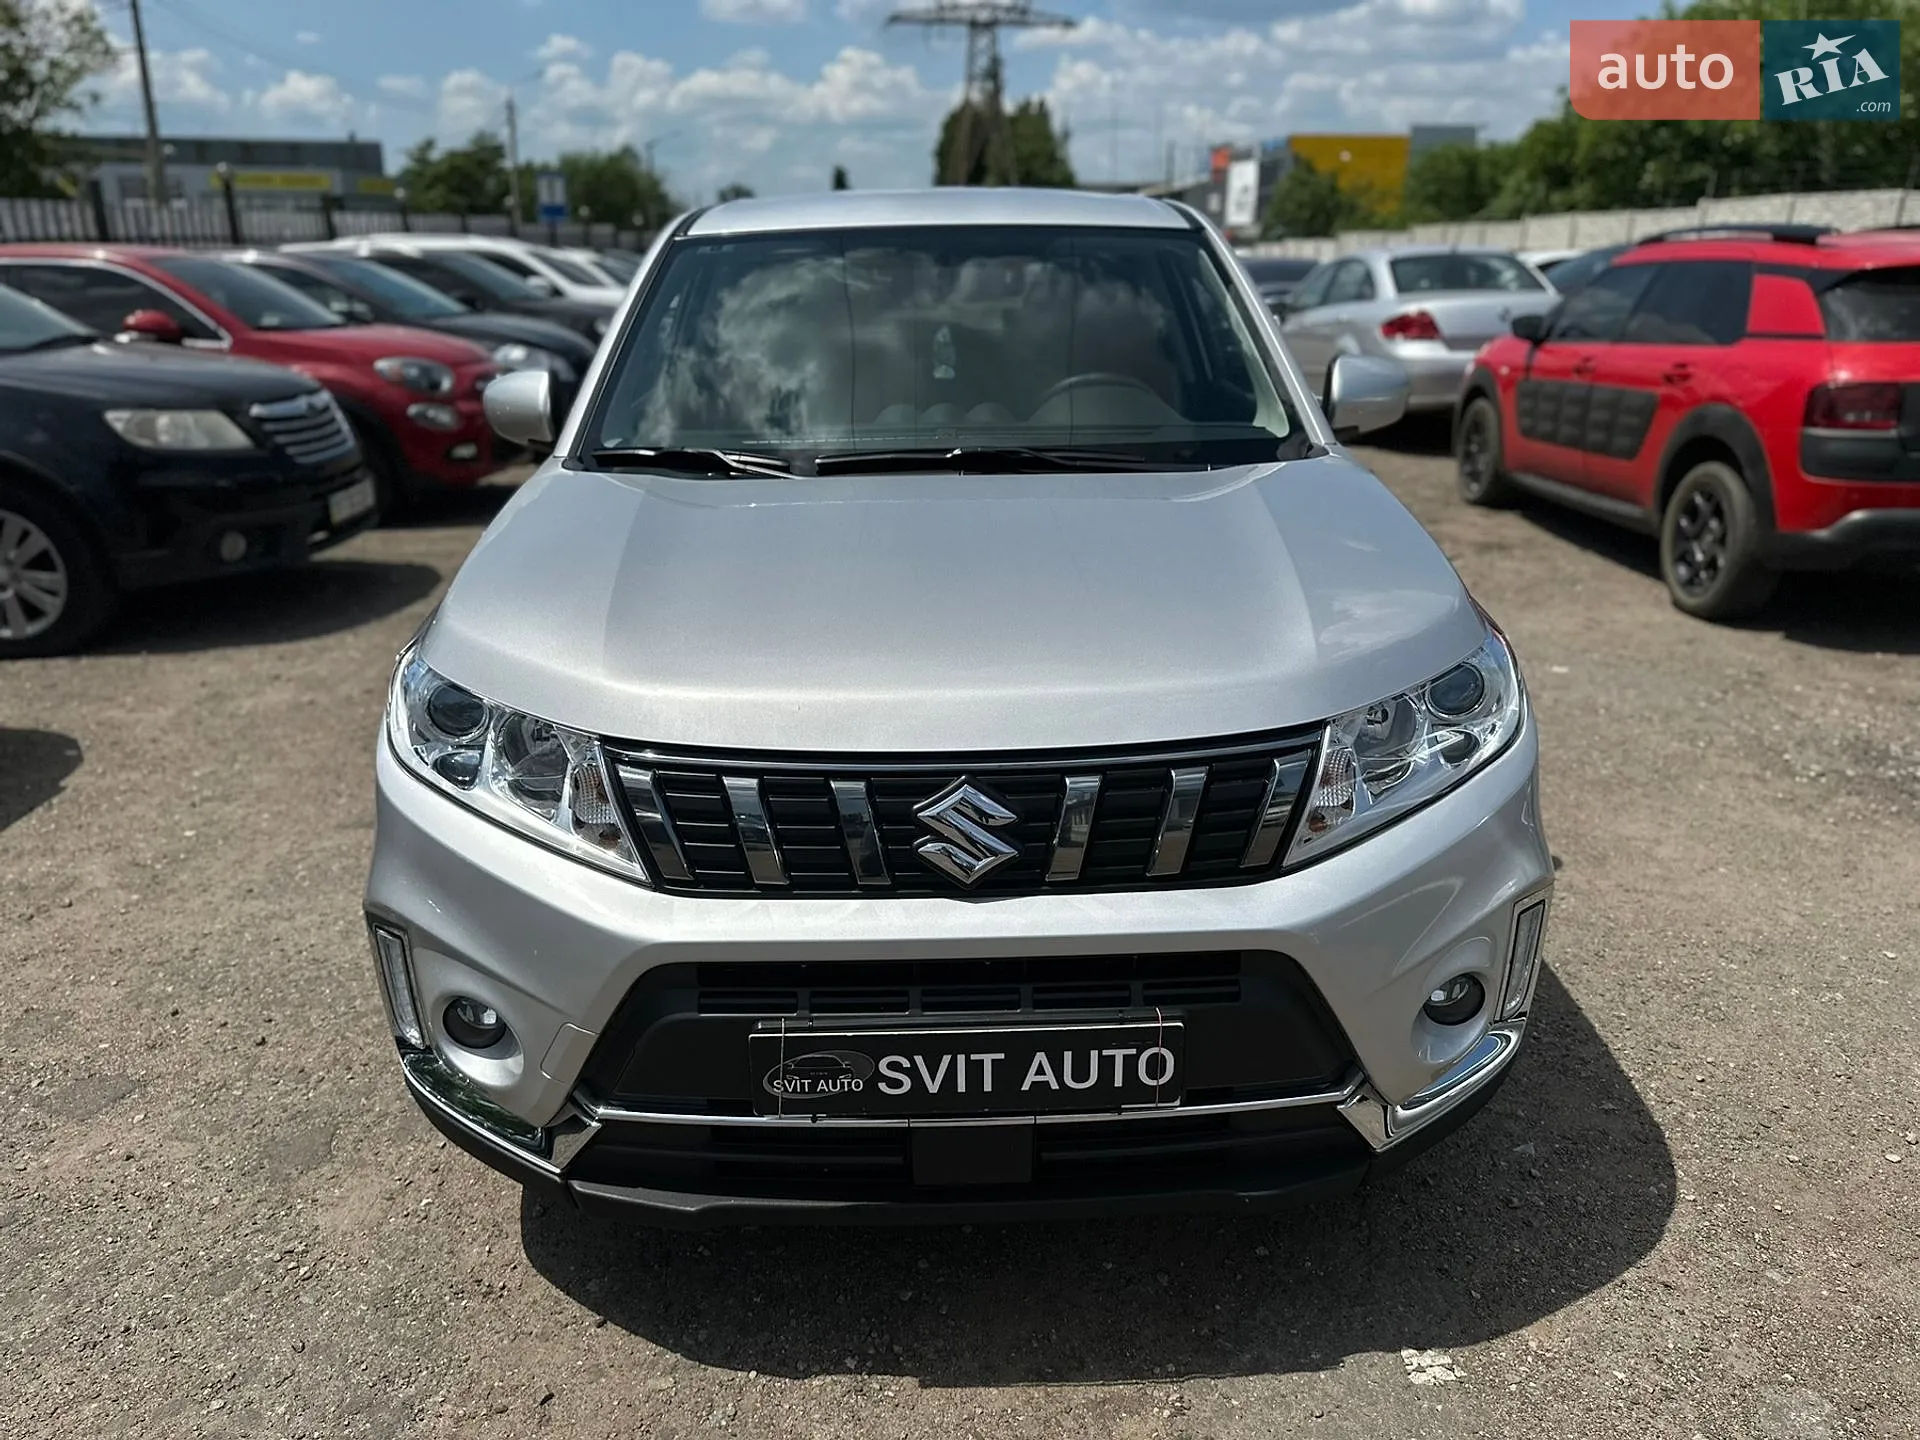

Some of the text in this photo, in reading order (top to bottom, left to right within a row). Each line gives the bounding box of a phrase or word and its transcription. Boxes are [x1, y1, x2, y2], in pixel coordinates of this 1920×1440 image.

[773, 1078, 863, 1094] SVIT AUTO
[877, 1046, 1175, 1095] SVIT AUTO
